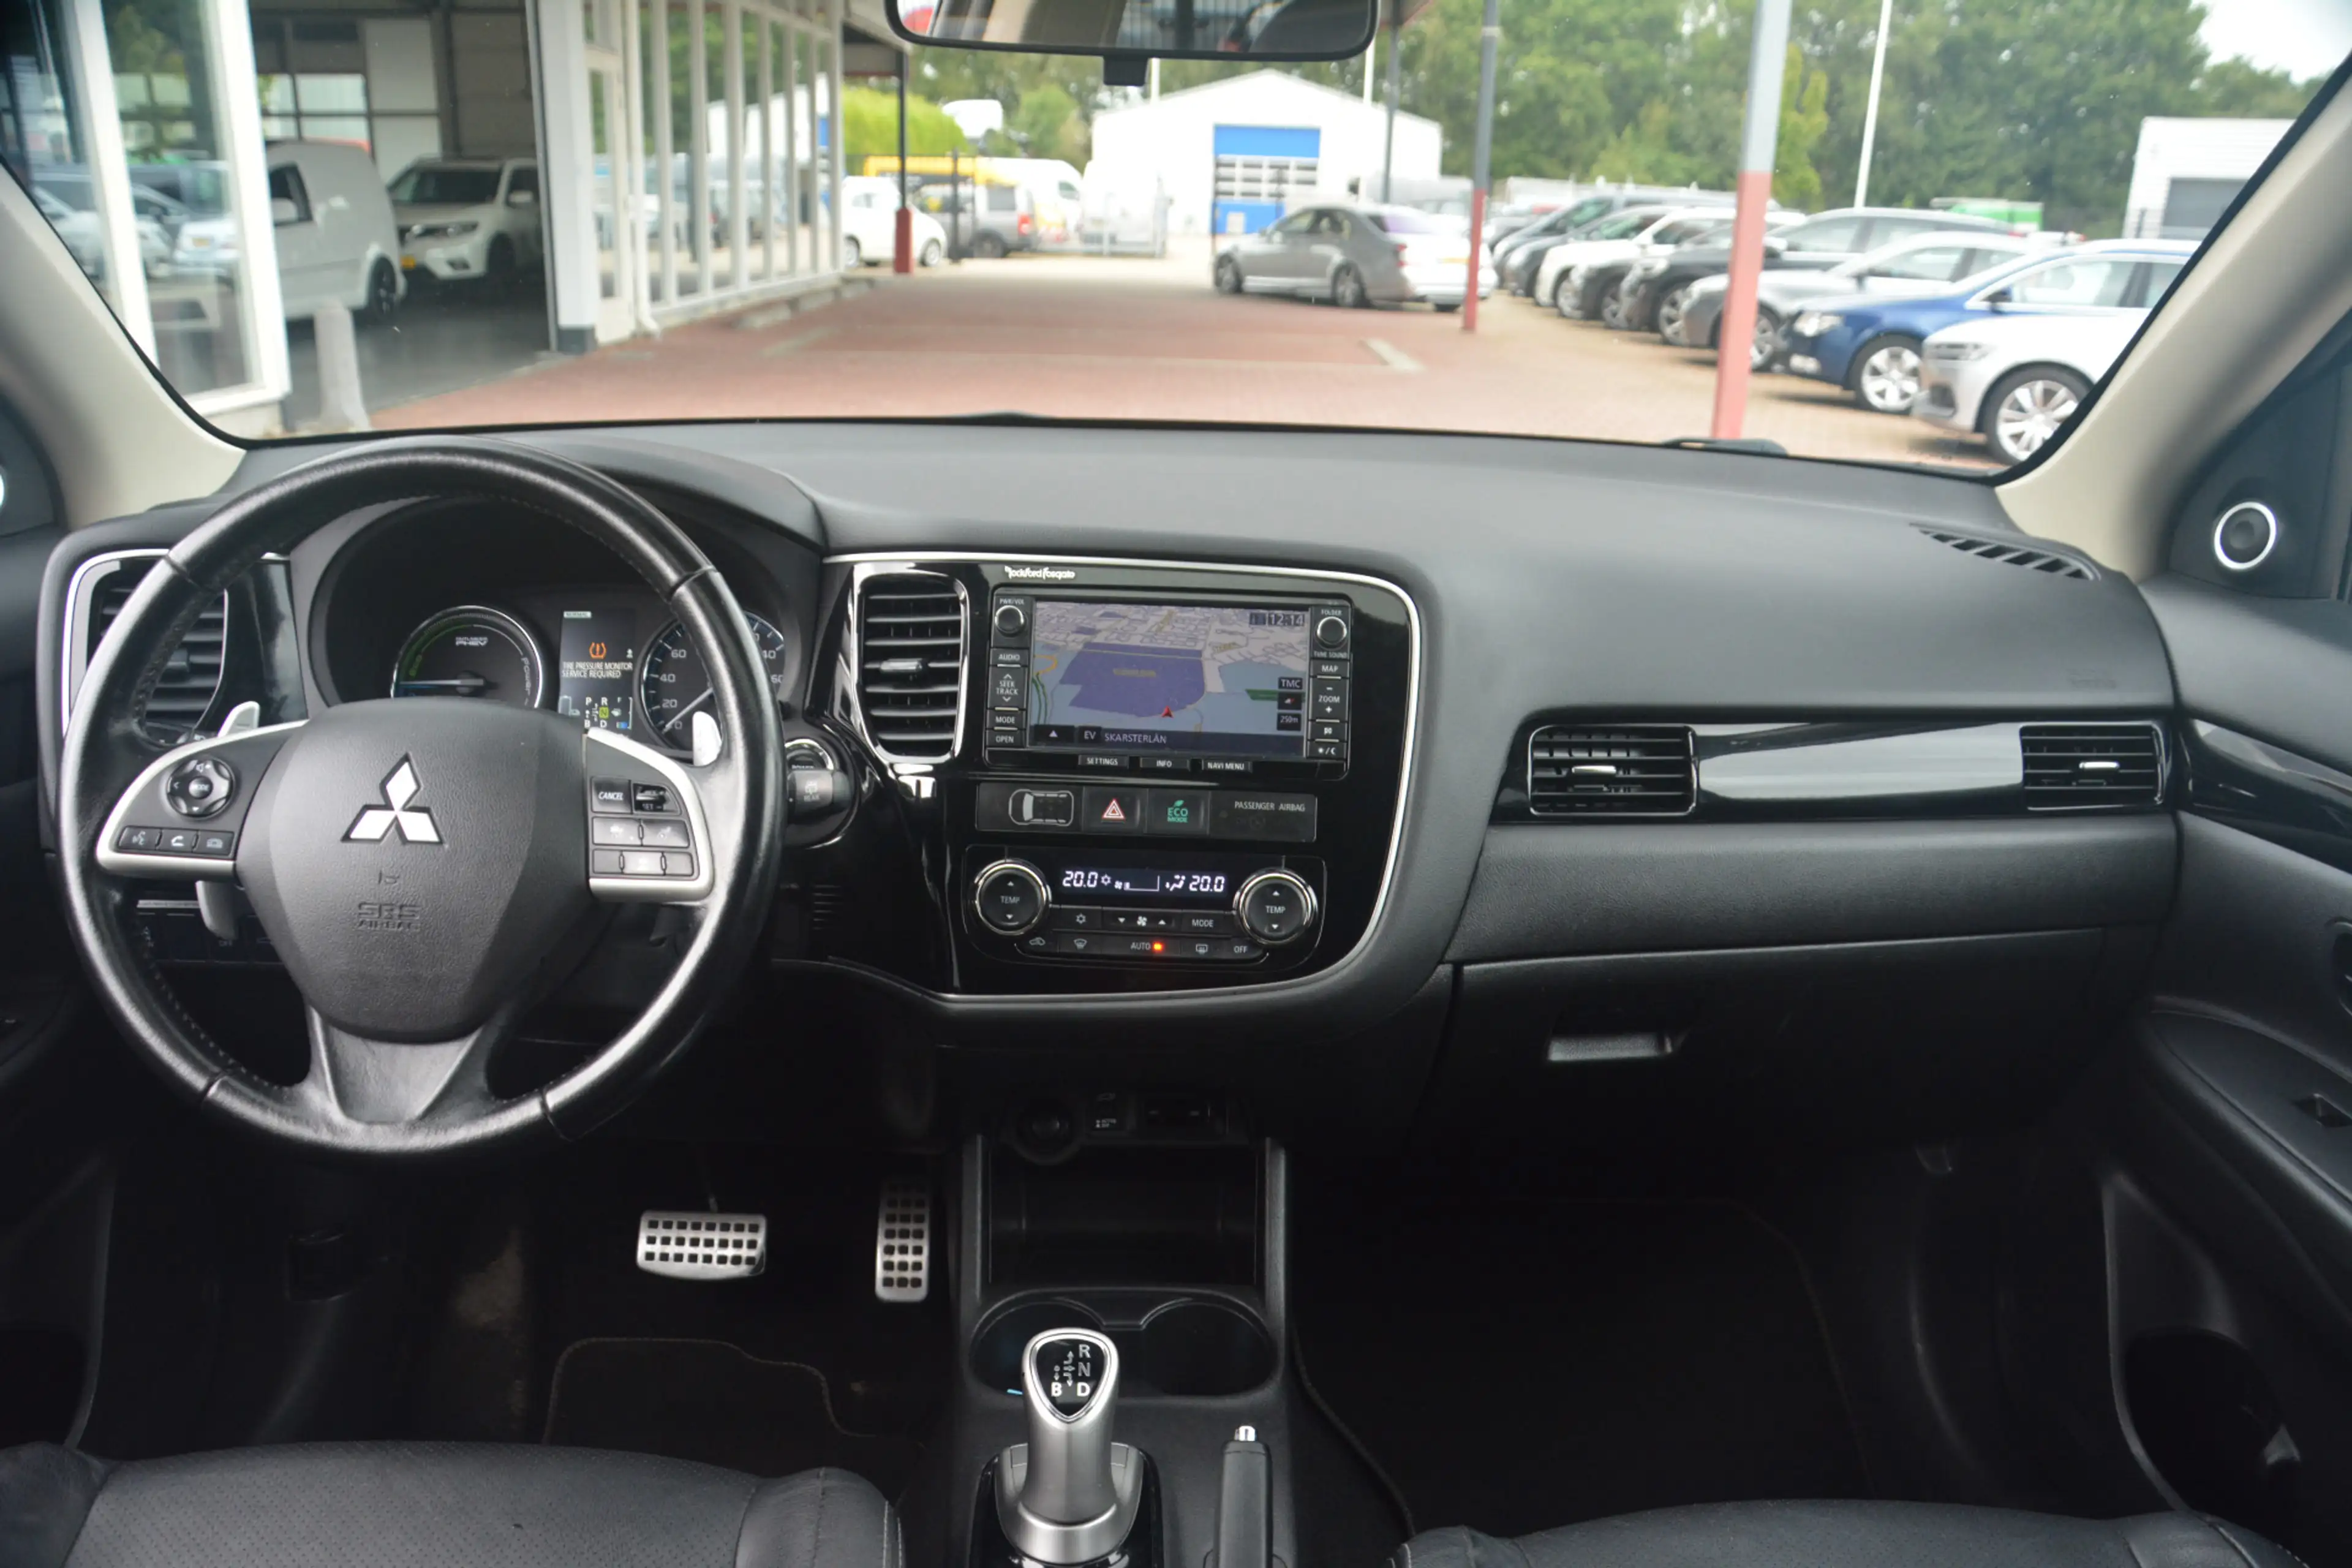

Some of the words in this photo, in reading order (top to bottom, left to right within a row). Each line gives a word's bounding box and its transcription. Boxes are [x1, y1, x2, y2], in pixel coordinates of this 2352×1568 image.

[1270, 613, 1305, 625] 12:14
[672, 649, 686, 658] 60
[576, 662, 603, 670] PRESSURE
[605, 662, 633, 671] MONITOR
[562, 669, 587, 678] SERVICE
[660, 674, 676, 683] 40
[1281, 679, 1301, 688] TMC
[586, 697, 592, 706] P
[662, 699, 677, 708] 20
[584, 720, 590, 728] B
[600, 720, 607, 728] D
[1084, 730, 1096, 739] EV
[598, 792, 624, 801] CANCEL
[1234, 801, 1275, 810] PASSENGER
[1279, 803, 1306, 812] AIRBAG
[1167, 807, 1188, 817] ECO
[1062, 870, 1098, 888] 20.0
[1189, 875, 1224, 892] 20.0
[358, 902, 421, 921] SRS
[1079, 1344, 1091, 1358] R
[1078, 1362, 1091, 1376] N
[1051, 1382, 1062, 1396] B
[1077, 1382, 1090, 1396] D
